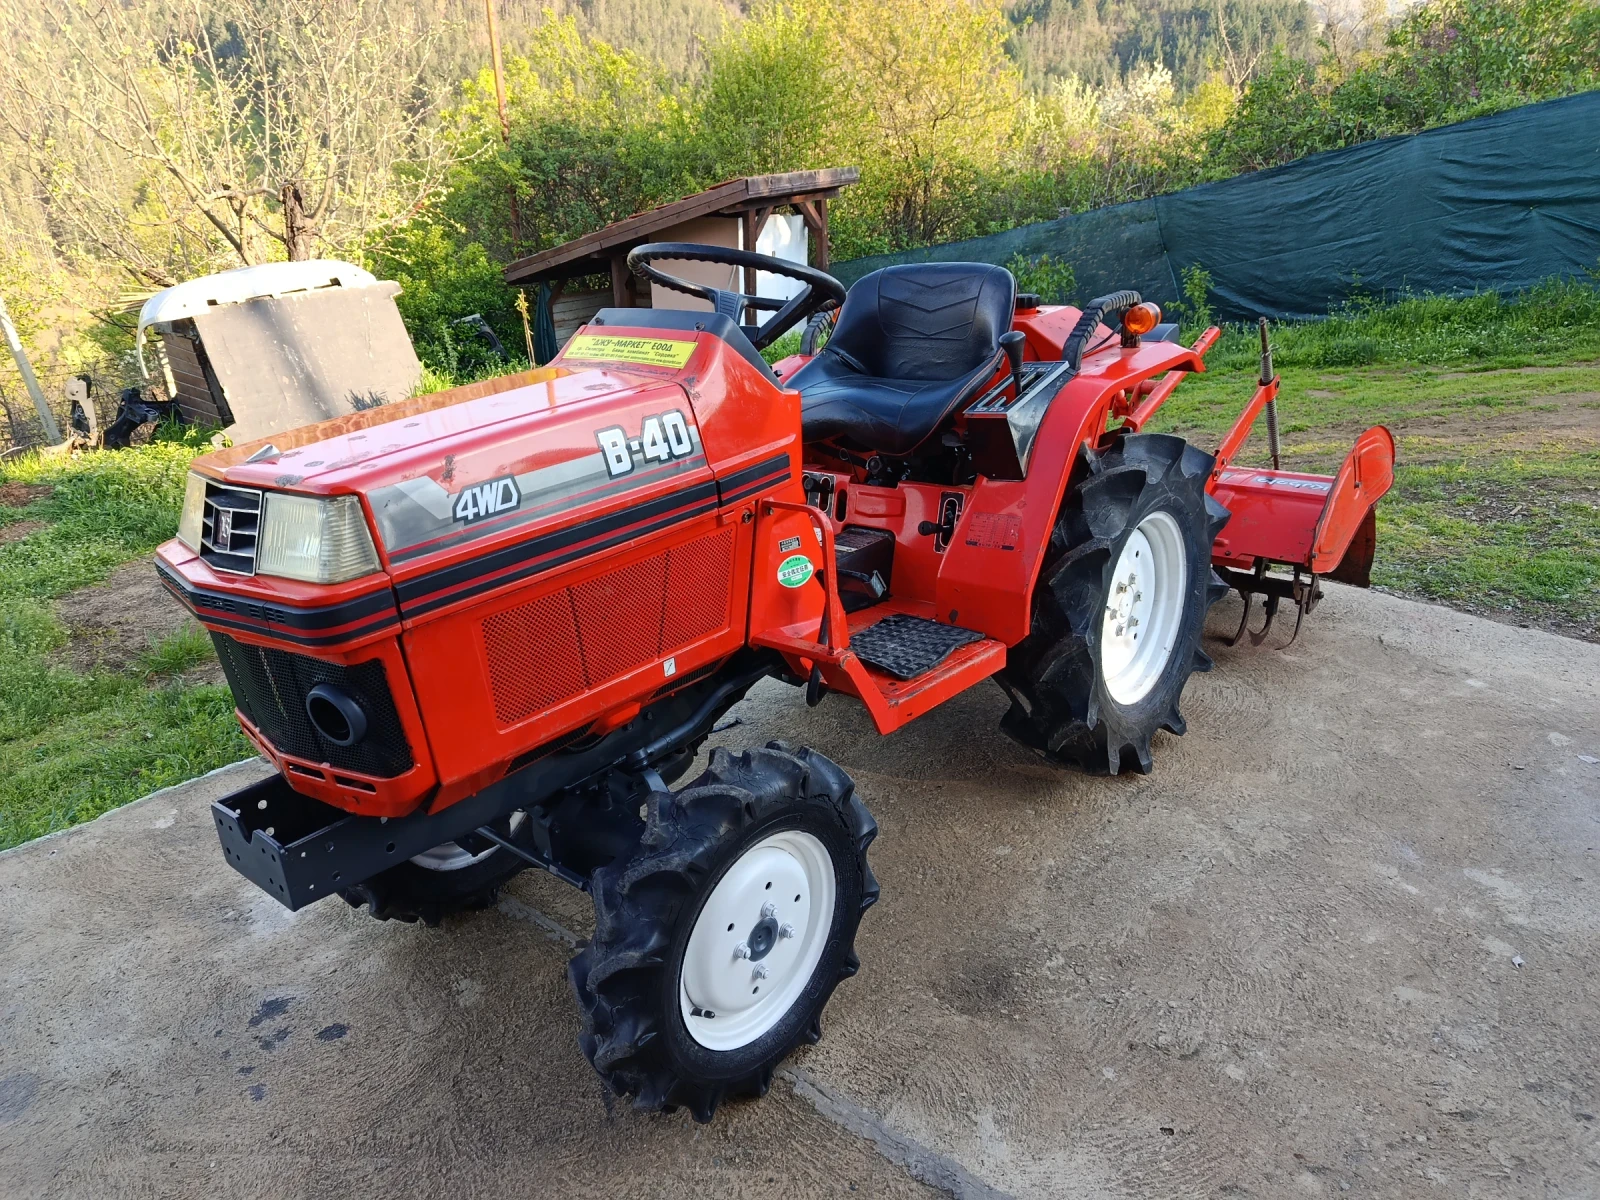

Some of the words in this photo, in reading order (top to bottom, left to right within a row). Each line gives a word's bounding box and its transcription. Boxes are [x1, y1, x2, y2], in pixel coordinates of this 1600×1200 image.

[651, 342, 673, 351] ЕООД
[597, 411, 692, 476] B-40
[1256, 477, 1330, 491] Kubota
[456, 477, 518, 520] 4WD
